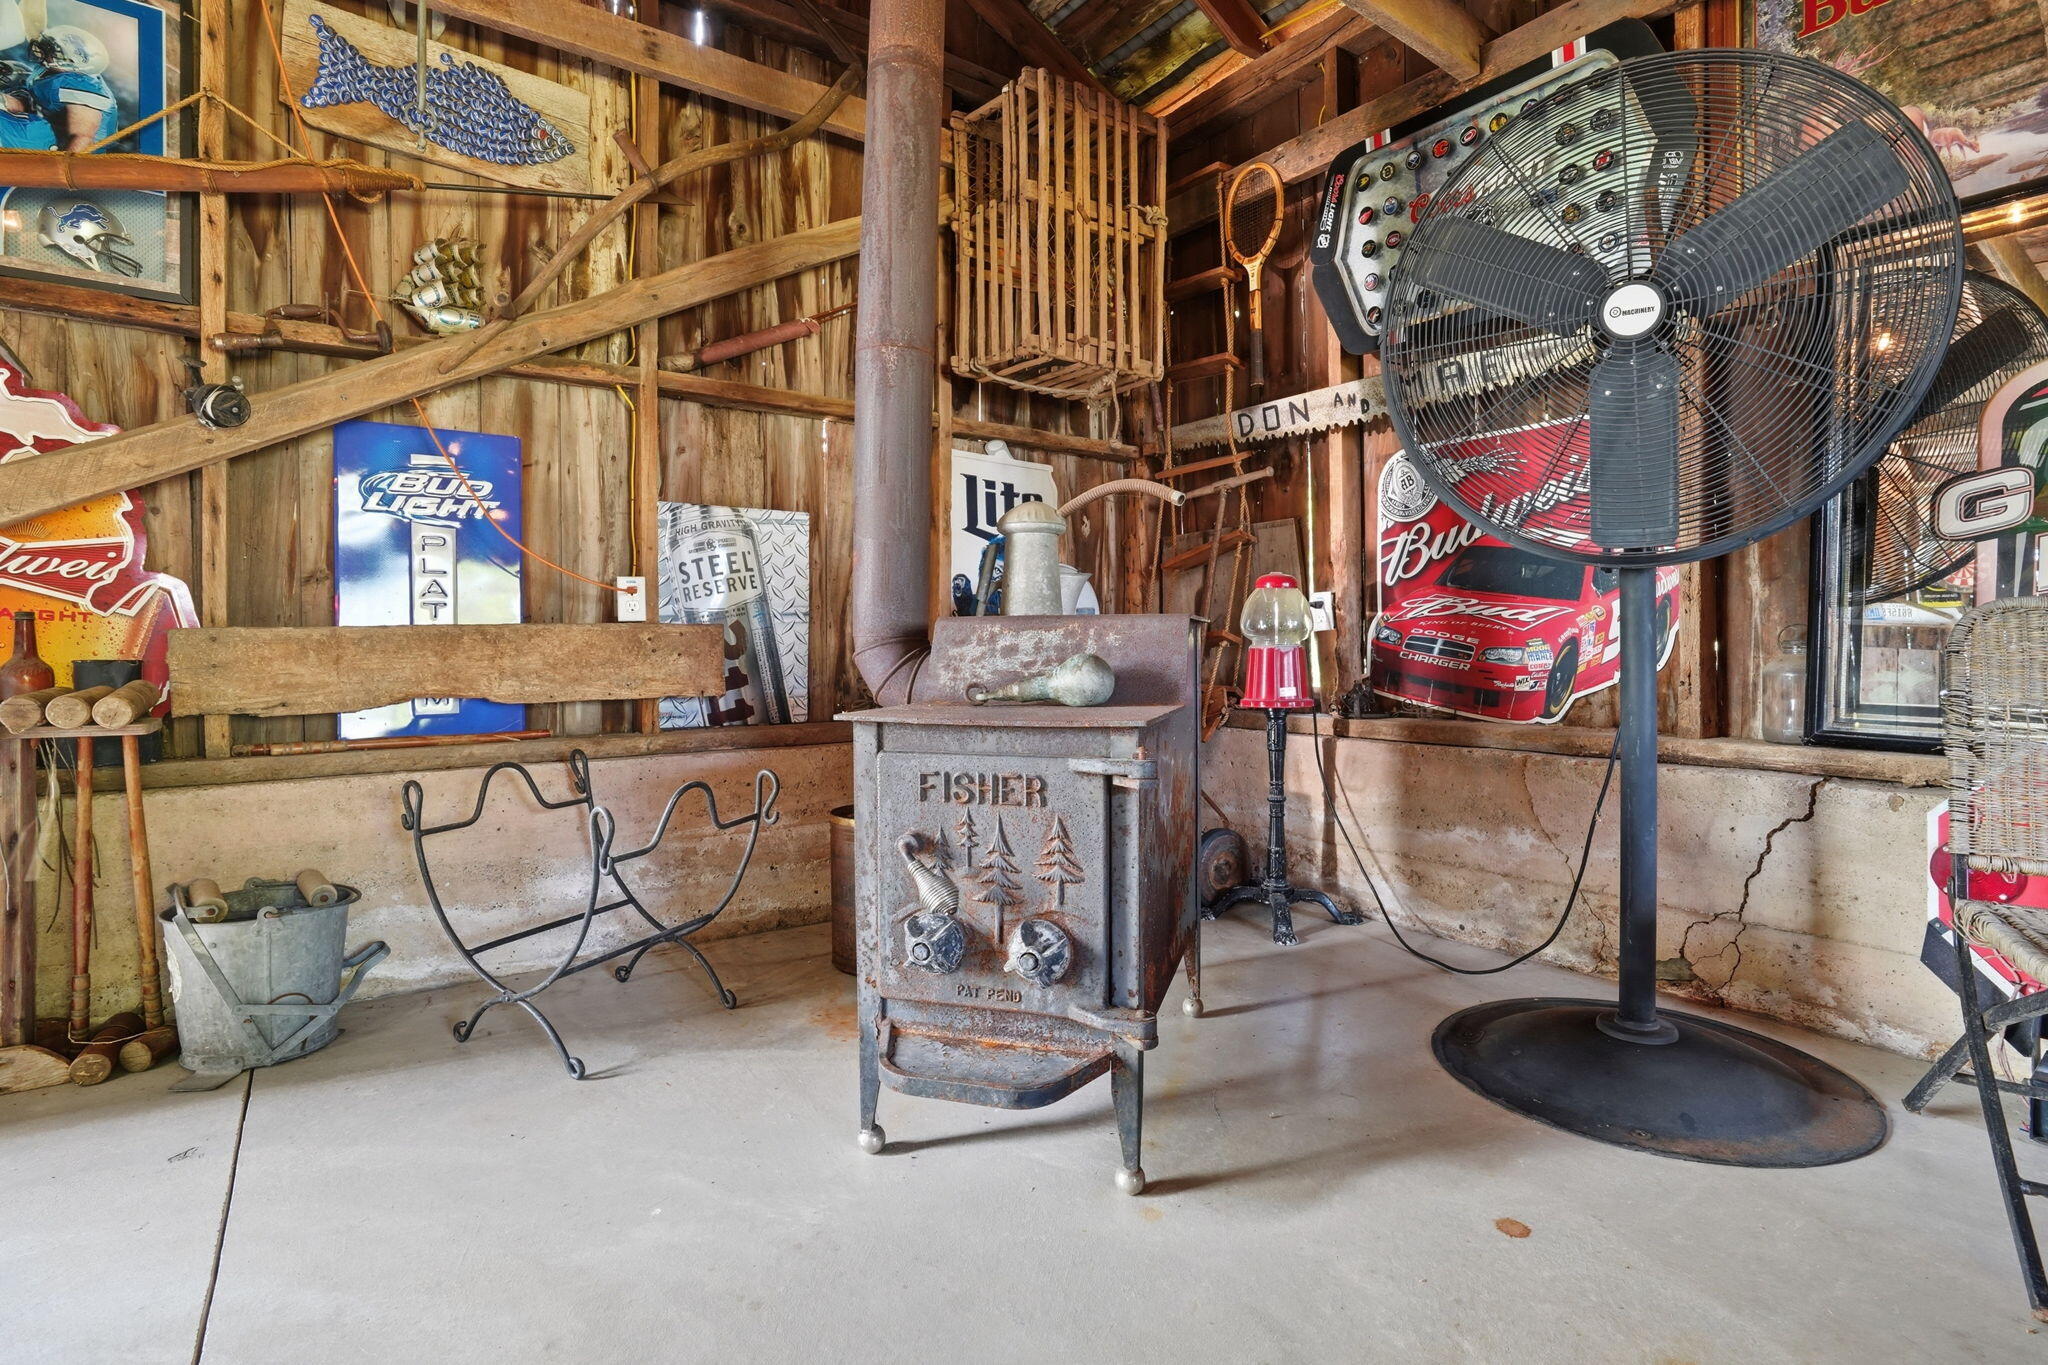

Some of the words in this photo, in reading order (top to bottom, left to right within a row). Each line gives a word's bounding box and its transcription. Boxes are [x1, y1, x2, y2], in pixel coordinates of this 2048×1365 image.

[1325, 203, 1336, 232] LIGHT
[1622, 306, 1655, 316] MACHINERY
[1238, 398, 1310, 437] DON
[1333, 392, 1371, 415] AND
[387, 472, 494, 498] BUD
[362, 491, 501, 520] LIGHT
[675, 523, 698, 537] HIGH
[701, 519, 742, 531] GRAVITY
[678, 550, 754, 585] STEEL
[682, 575, 758, 603] RESERVE
[0, 607, 93, 622] AGHT
[421, 535, 449, 707] PLATM
[1401, 597, 1557, 622] Bud
[1410, 628, 1481, 645] DODGE
[1400, 651, 1471, 671] CHARGER
[918, 771, 1048, 807] FISHER
[957, 984, 982, 998] PAT
[986, 988, 1022, 1003] PEND
